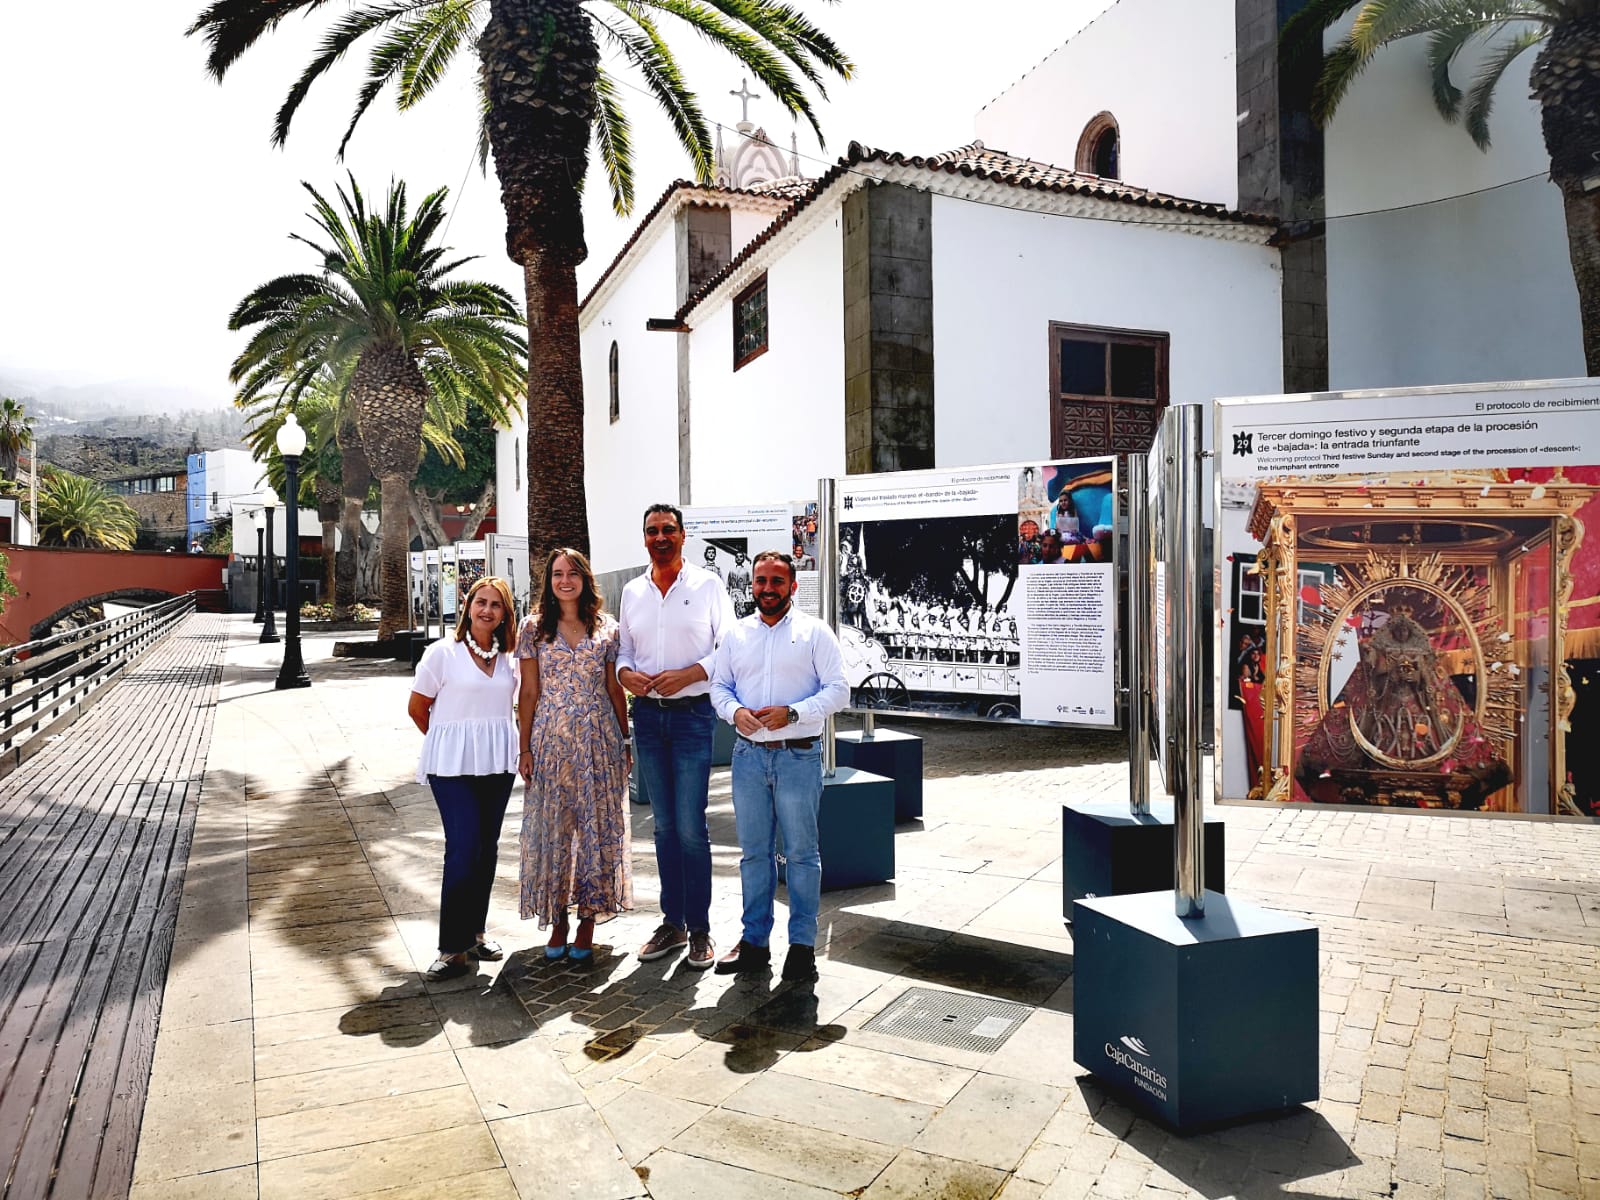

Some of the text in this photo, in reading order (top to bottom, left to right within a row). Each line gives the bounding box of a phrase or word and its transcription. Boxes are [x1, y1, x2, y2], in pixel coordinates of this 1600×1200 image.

[1475, 397, 1600, 411] El protocolo de recibimient
[1257, 419, 1538, 441] Tercer domingo festivo y segunda etapa de la procesión
[1237, 439, 1249, 449] 29
[1257, 443, 1270, 453] de
[1320, 440, 1329, 450] la
[1331, 439, 1369, 450] entrada
[1372, 436, 1420, 448] triunfante
[1257, 455, 1292, 463] Welcoming
[1294, 454, 1321, 463] protocol
[1322, 453, 1341, 461] Third
[1342, 452, 1366, 460] festive
[1367, 451, 1394, 460] Sunday
[1395, 450, 1410, 458] and
[1412, 449, 1438, 458] second
[1441, 449, 1461, 457] stage
[1472, 447, 1484, 455] the
[1486, 446, 1528, 456] procession
[1270, 463, 1307, 472] triumphant
[1308, 462, 1340, 470] entrance
[1105, 1043, 1167, 1089] CajaCanarias
